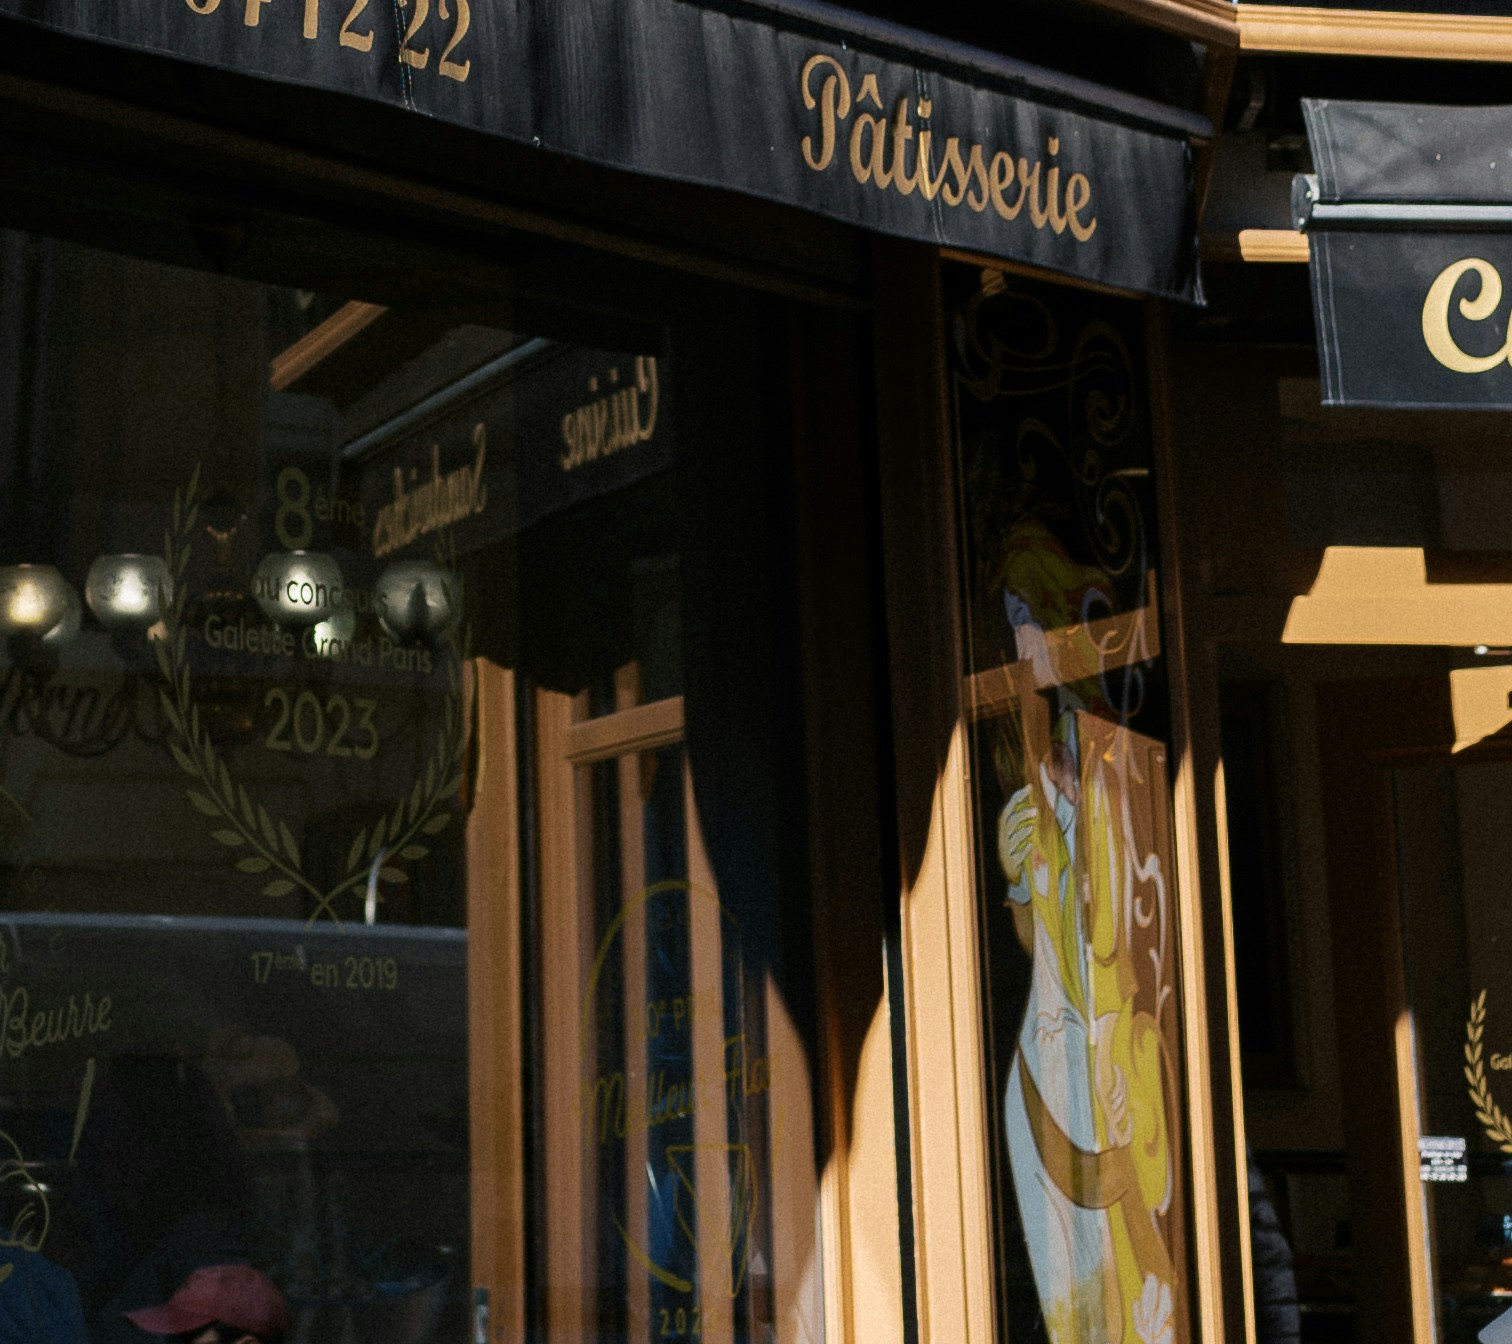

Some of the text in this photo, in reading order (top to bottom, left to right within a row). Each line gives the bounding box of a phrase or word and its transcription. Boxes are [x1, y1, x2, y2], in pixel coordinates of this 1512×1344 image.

[801, 53, 1098, 244] Pâtisserie
[204, 614, 435, 675] Galette Grand Paris
[263, 687, 379, 760] 2023
[309, 963, 338, 988] en
[344, 956, 399, 991] 2019
